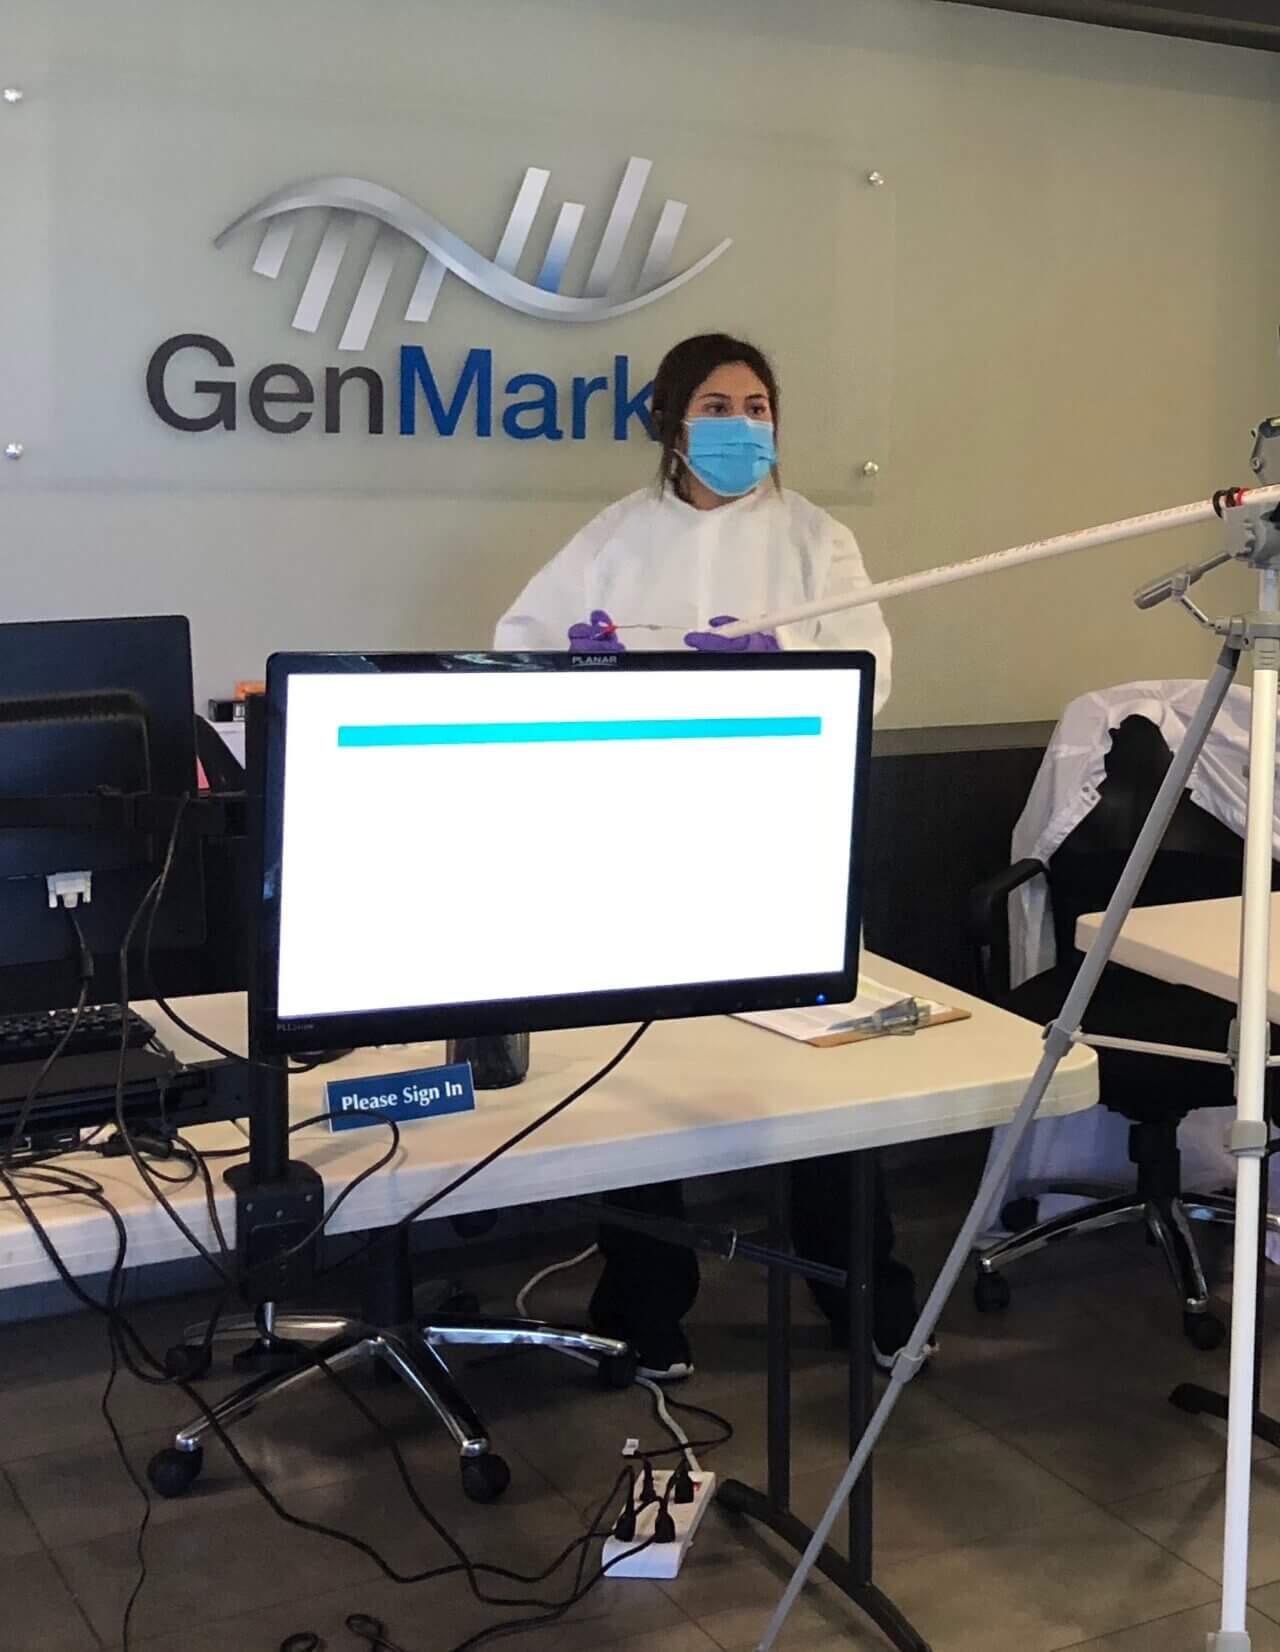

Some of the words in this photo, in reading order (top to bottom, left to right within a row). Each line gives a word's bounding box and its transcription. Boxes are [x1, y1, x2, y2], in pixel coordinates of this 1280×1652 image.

[145, 333, 661, 442] GenMark
[571, 655, 618, 665] PLANAR
[341, 1093, 399, 1111] Please
[402, 1084, 440, 1106] Sign
[445, 1080, 463, 1097] In
